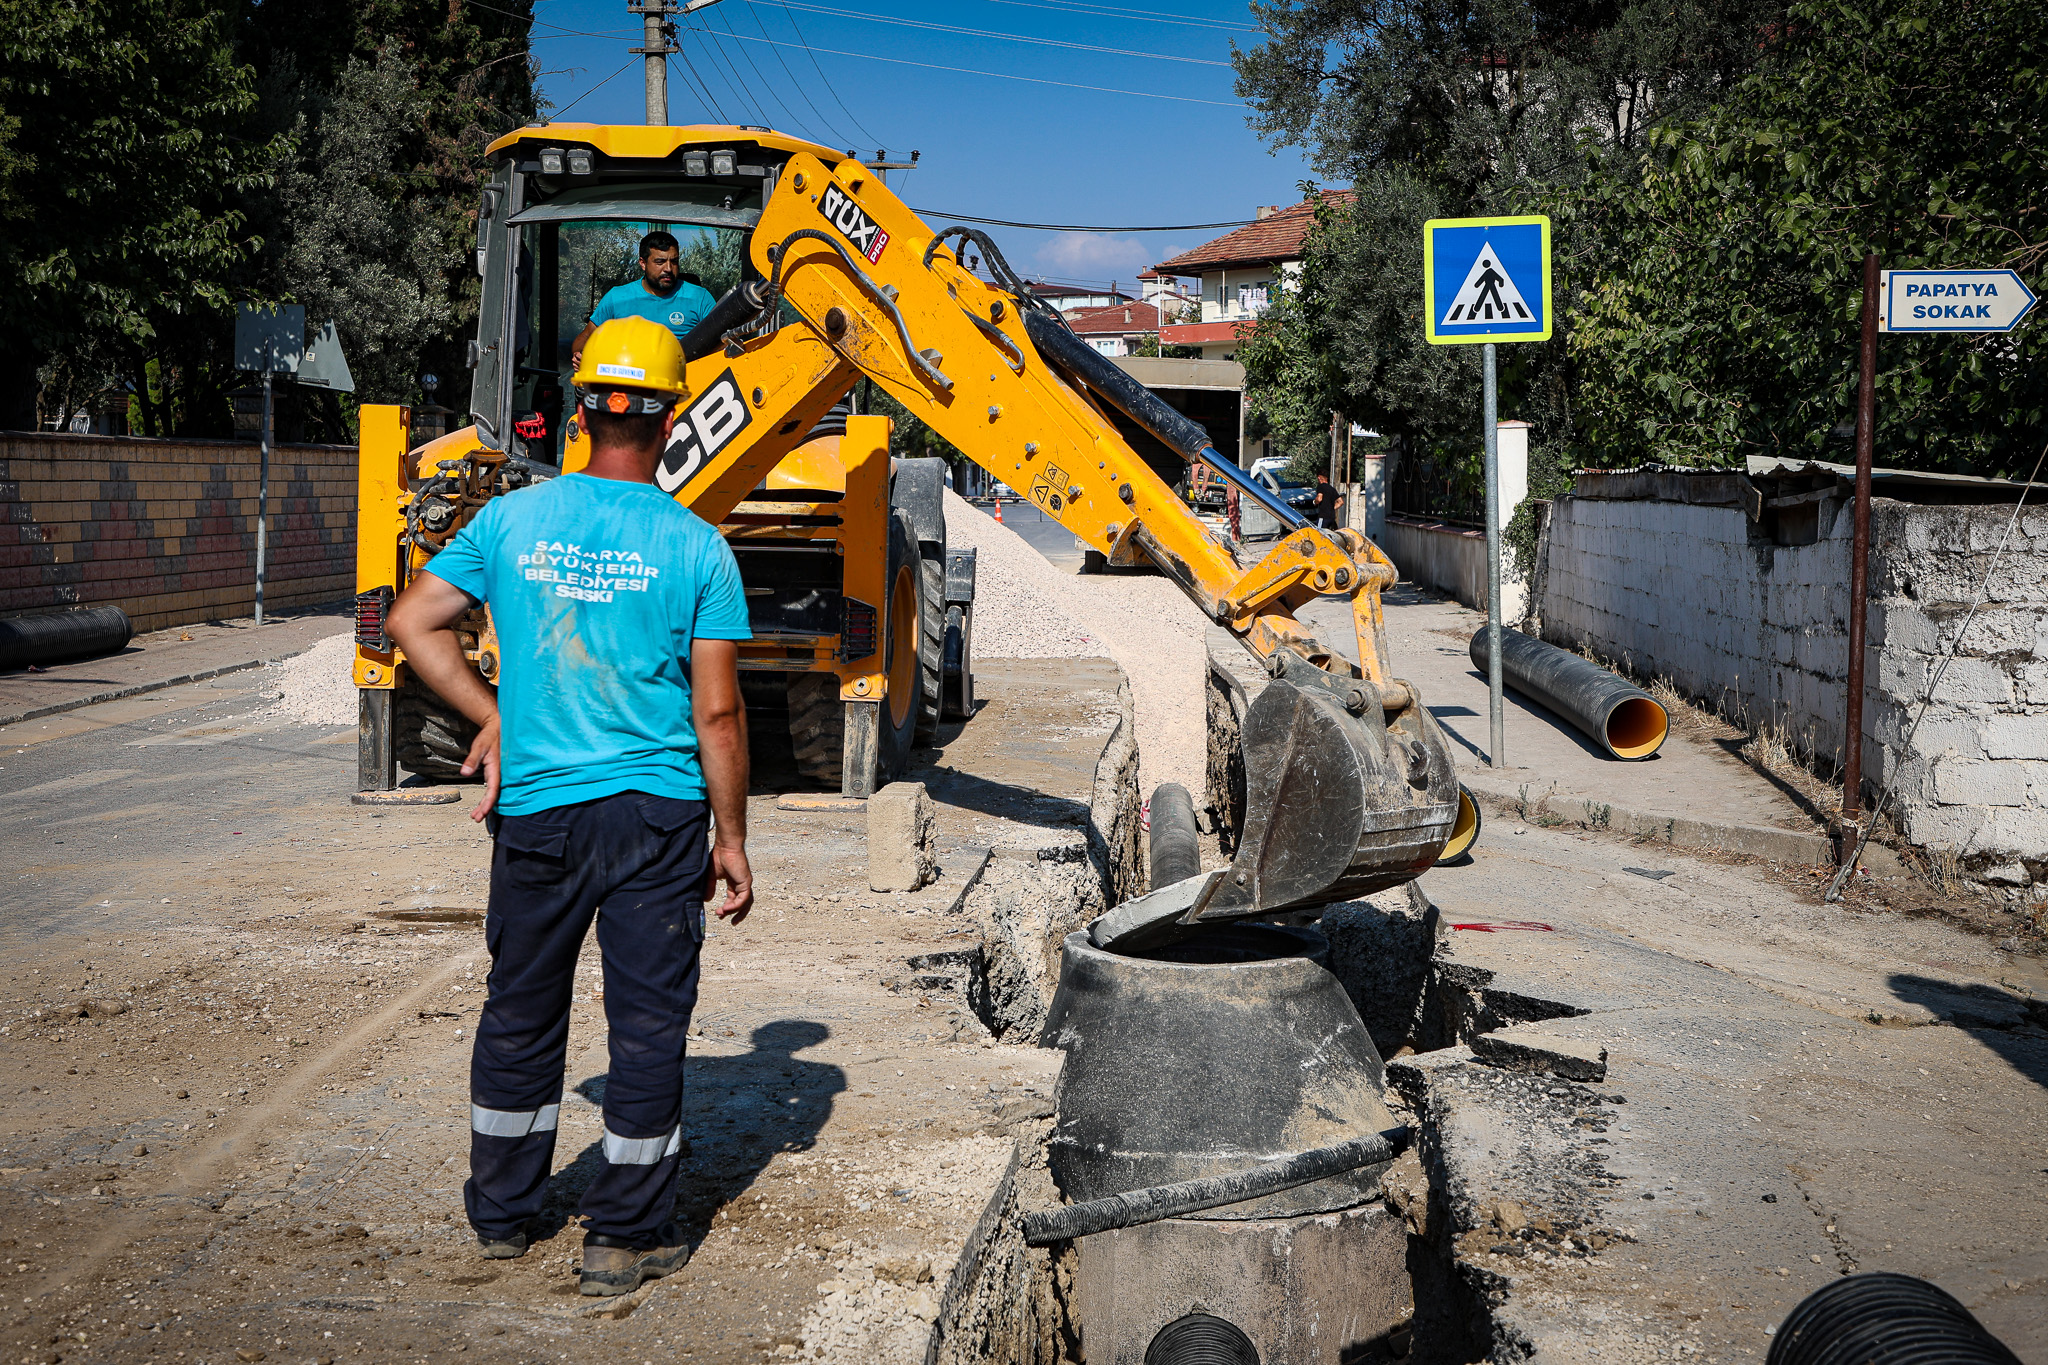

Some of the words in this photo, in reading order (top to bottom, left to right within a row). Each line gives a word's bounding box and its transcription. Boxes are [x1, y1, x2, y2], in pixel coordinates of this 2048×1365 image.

[870, 233, 888, 263] PRO
[1906, 283, 1999, 298] PAPATYA
[1912, 304, 1992, 319] SOKAK
[653, 380, 745, 493] CB
[517, 553, 660, 579] BÜYÜKŞEHİR
[524, 568, 649, 593] BELEDİYESİ
